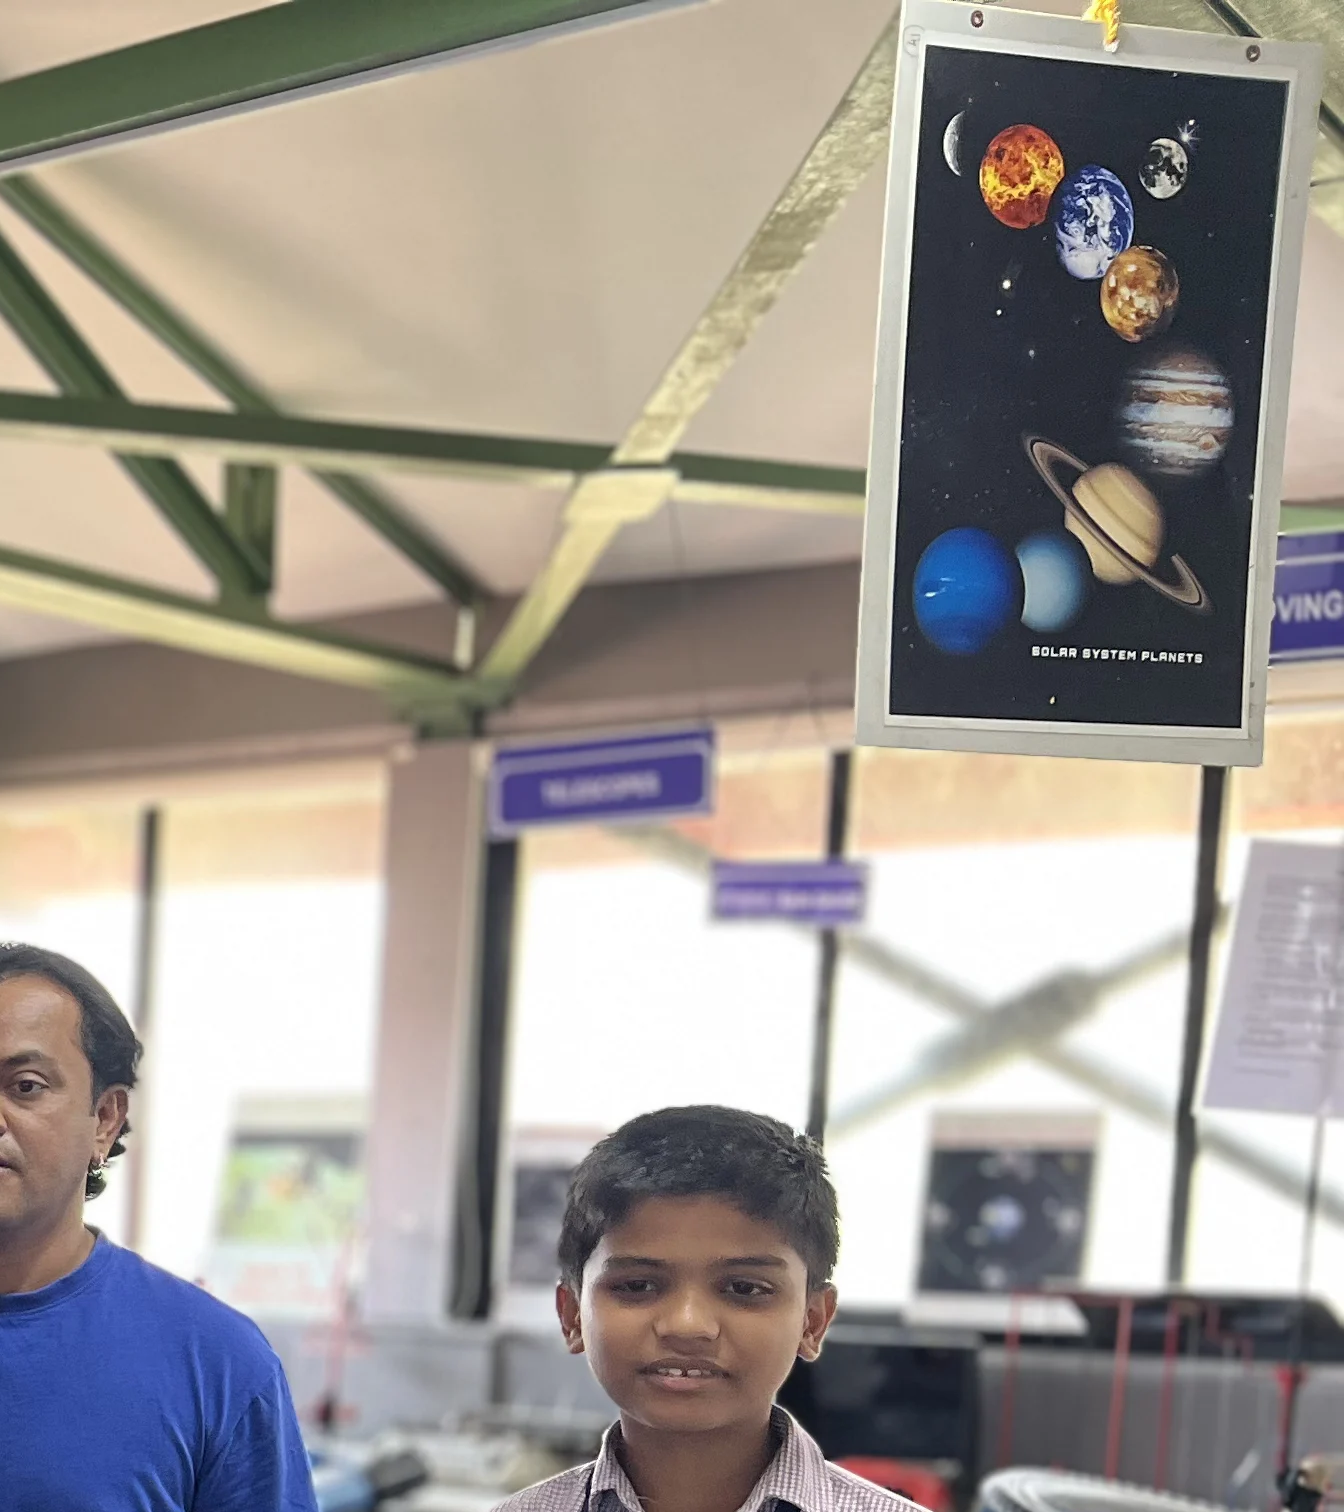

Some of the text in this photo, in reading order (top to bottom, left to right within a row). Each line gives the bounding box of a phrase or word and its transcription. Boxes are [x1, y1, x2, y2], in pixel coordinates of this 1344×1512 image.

[1274, 588, 1344, 623] VING
[1031, 646, 1203, 664] SOLAR SYSTEM PLANETS
